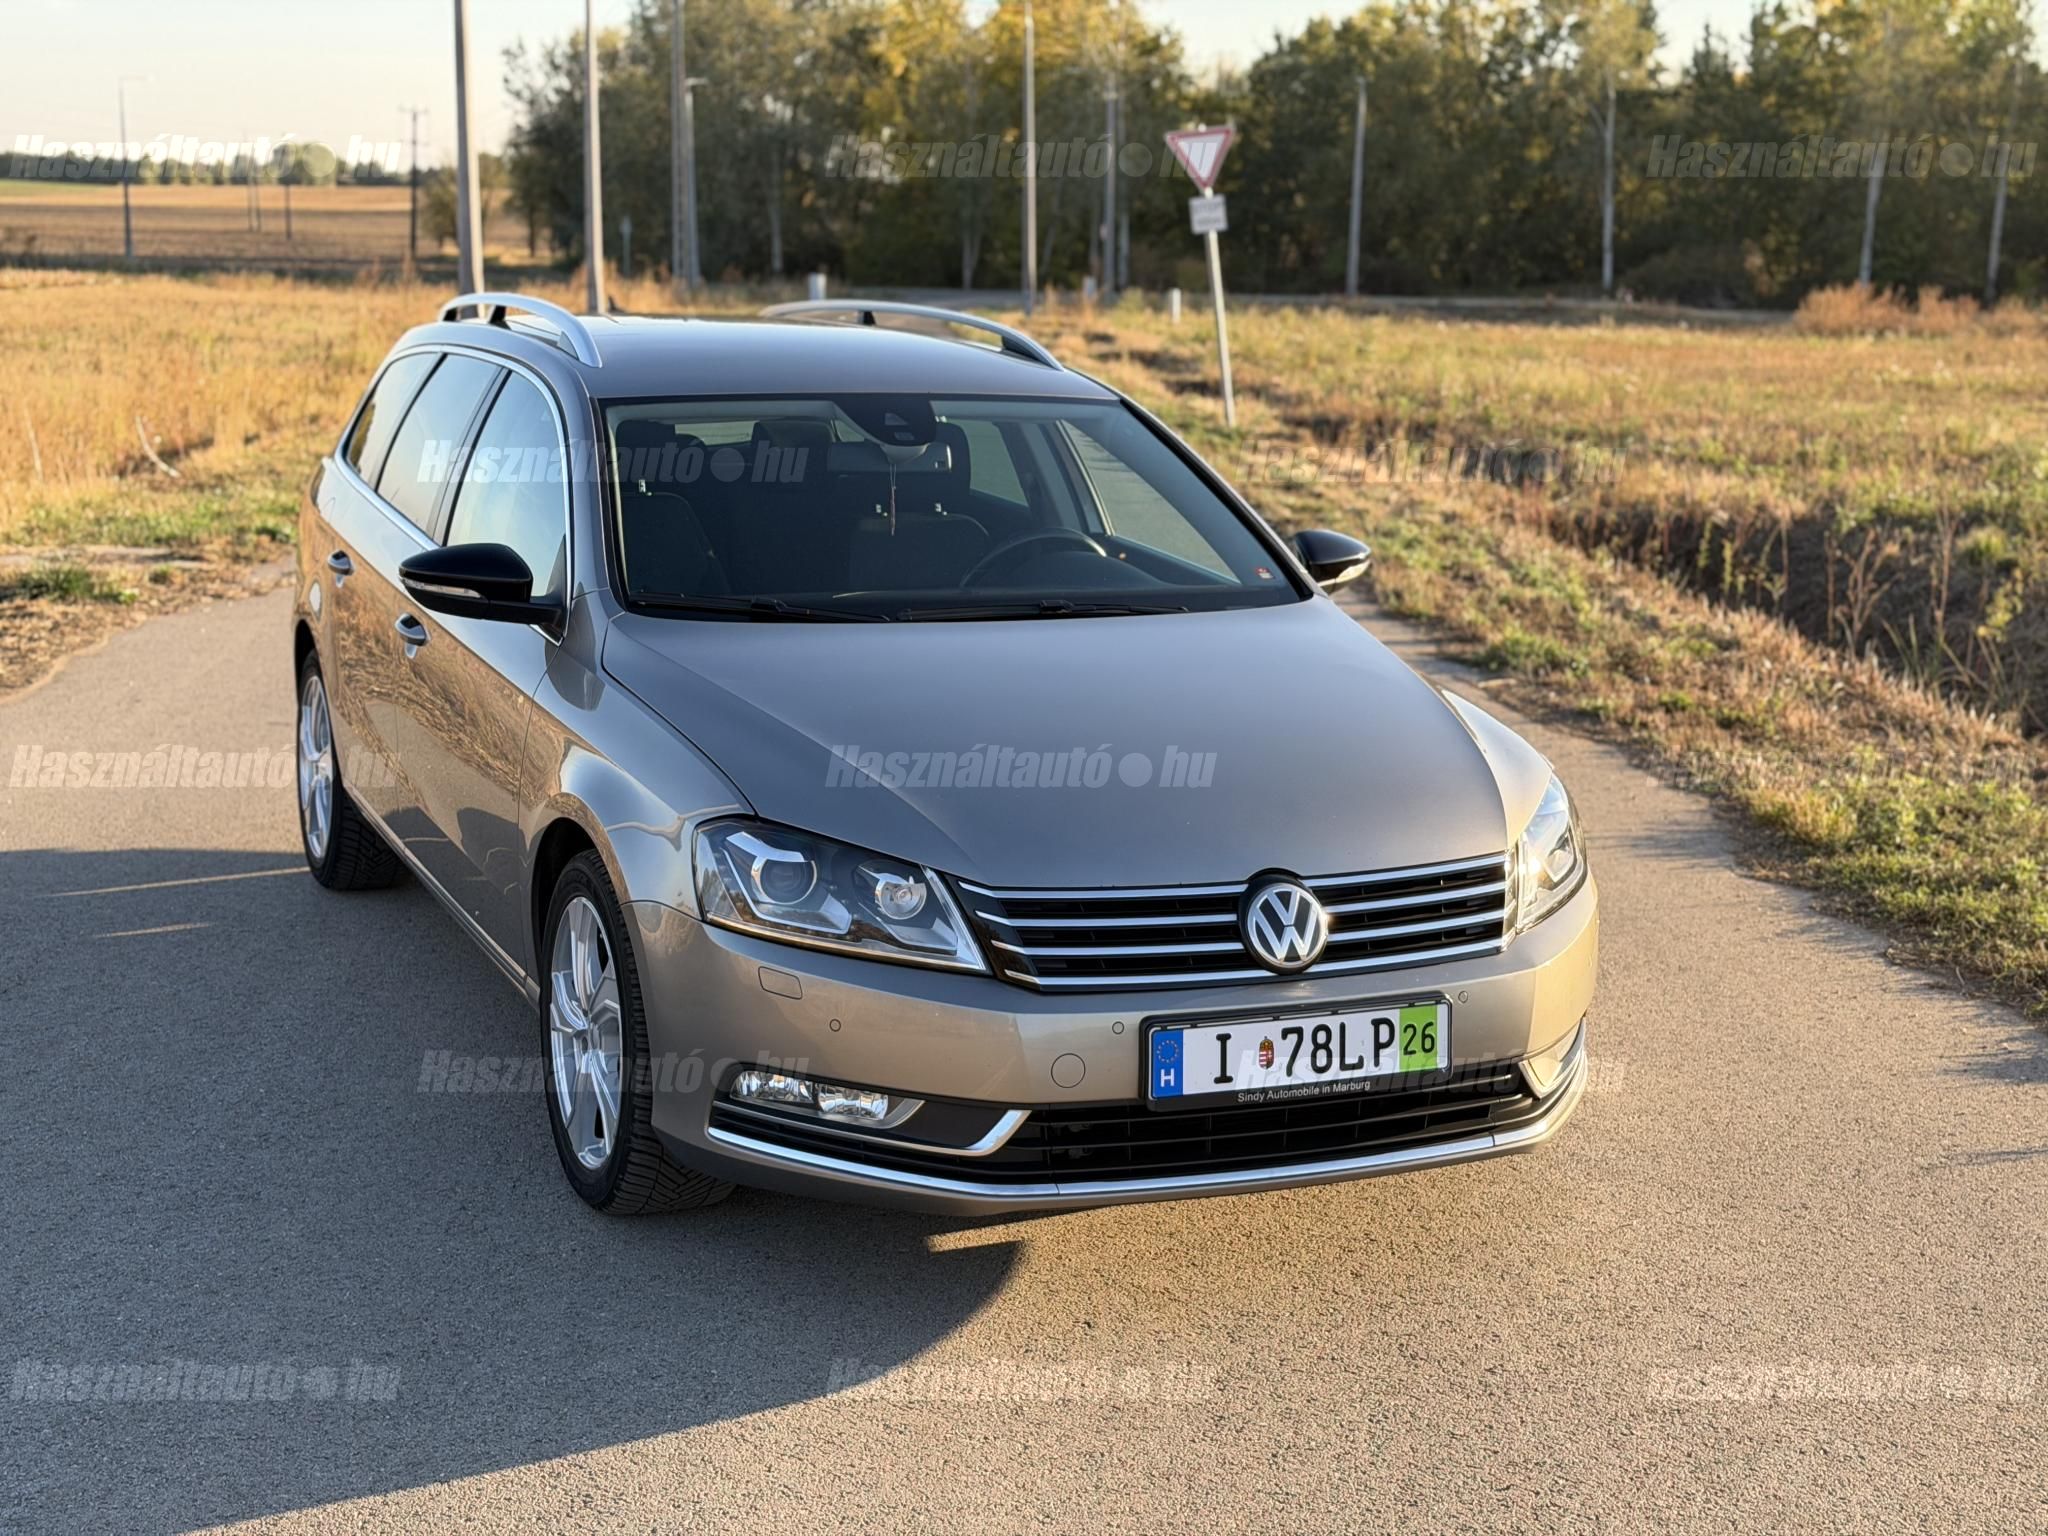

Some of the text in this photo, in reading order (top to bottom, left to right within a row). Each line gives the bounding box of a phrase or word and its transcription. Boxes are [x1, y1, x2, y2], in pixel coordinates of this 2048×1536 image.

[1281, 1018, 1395, 1077] 78LP
[1403, 1023, 1435, 1056] 26
[1160, 1068, 1175, 1087] H
[1237, 1080, 1371, 1102] Sindy Automobile in Marburg
